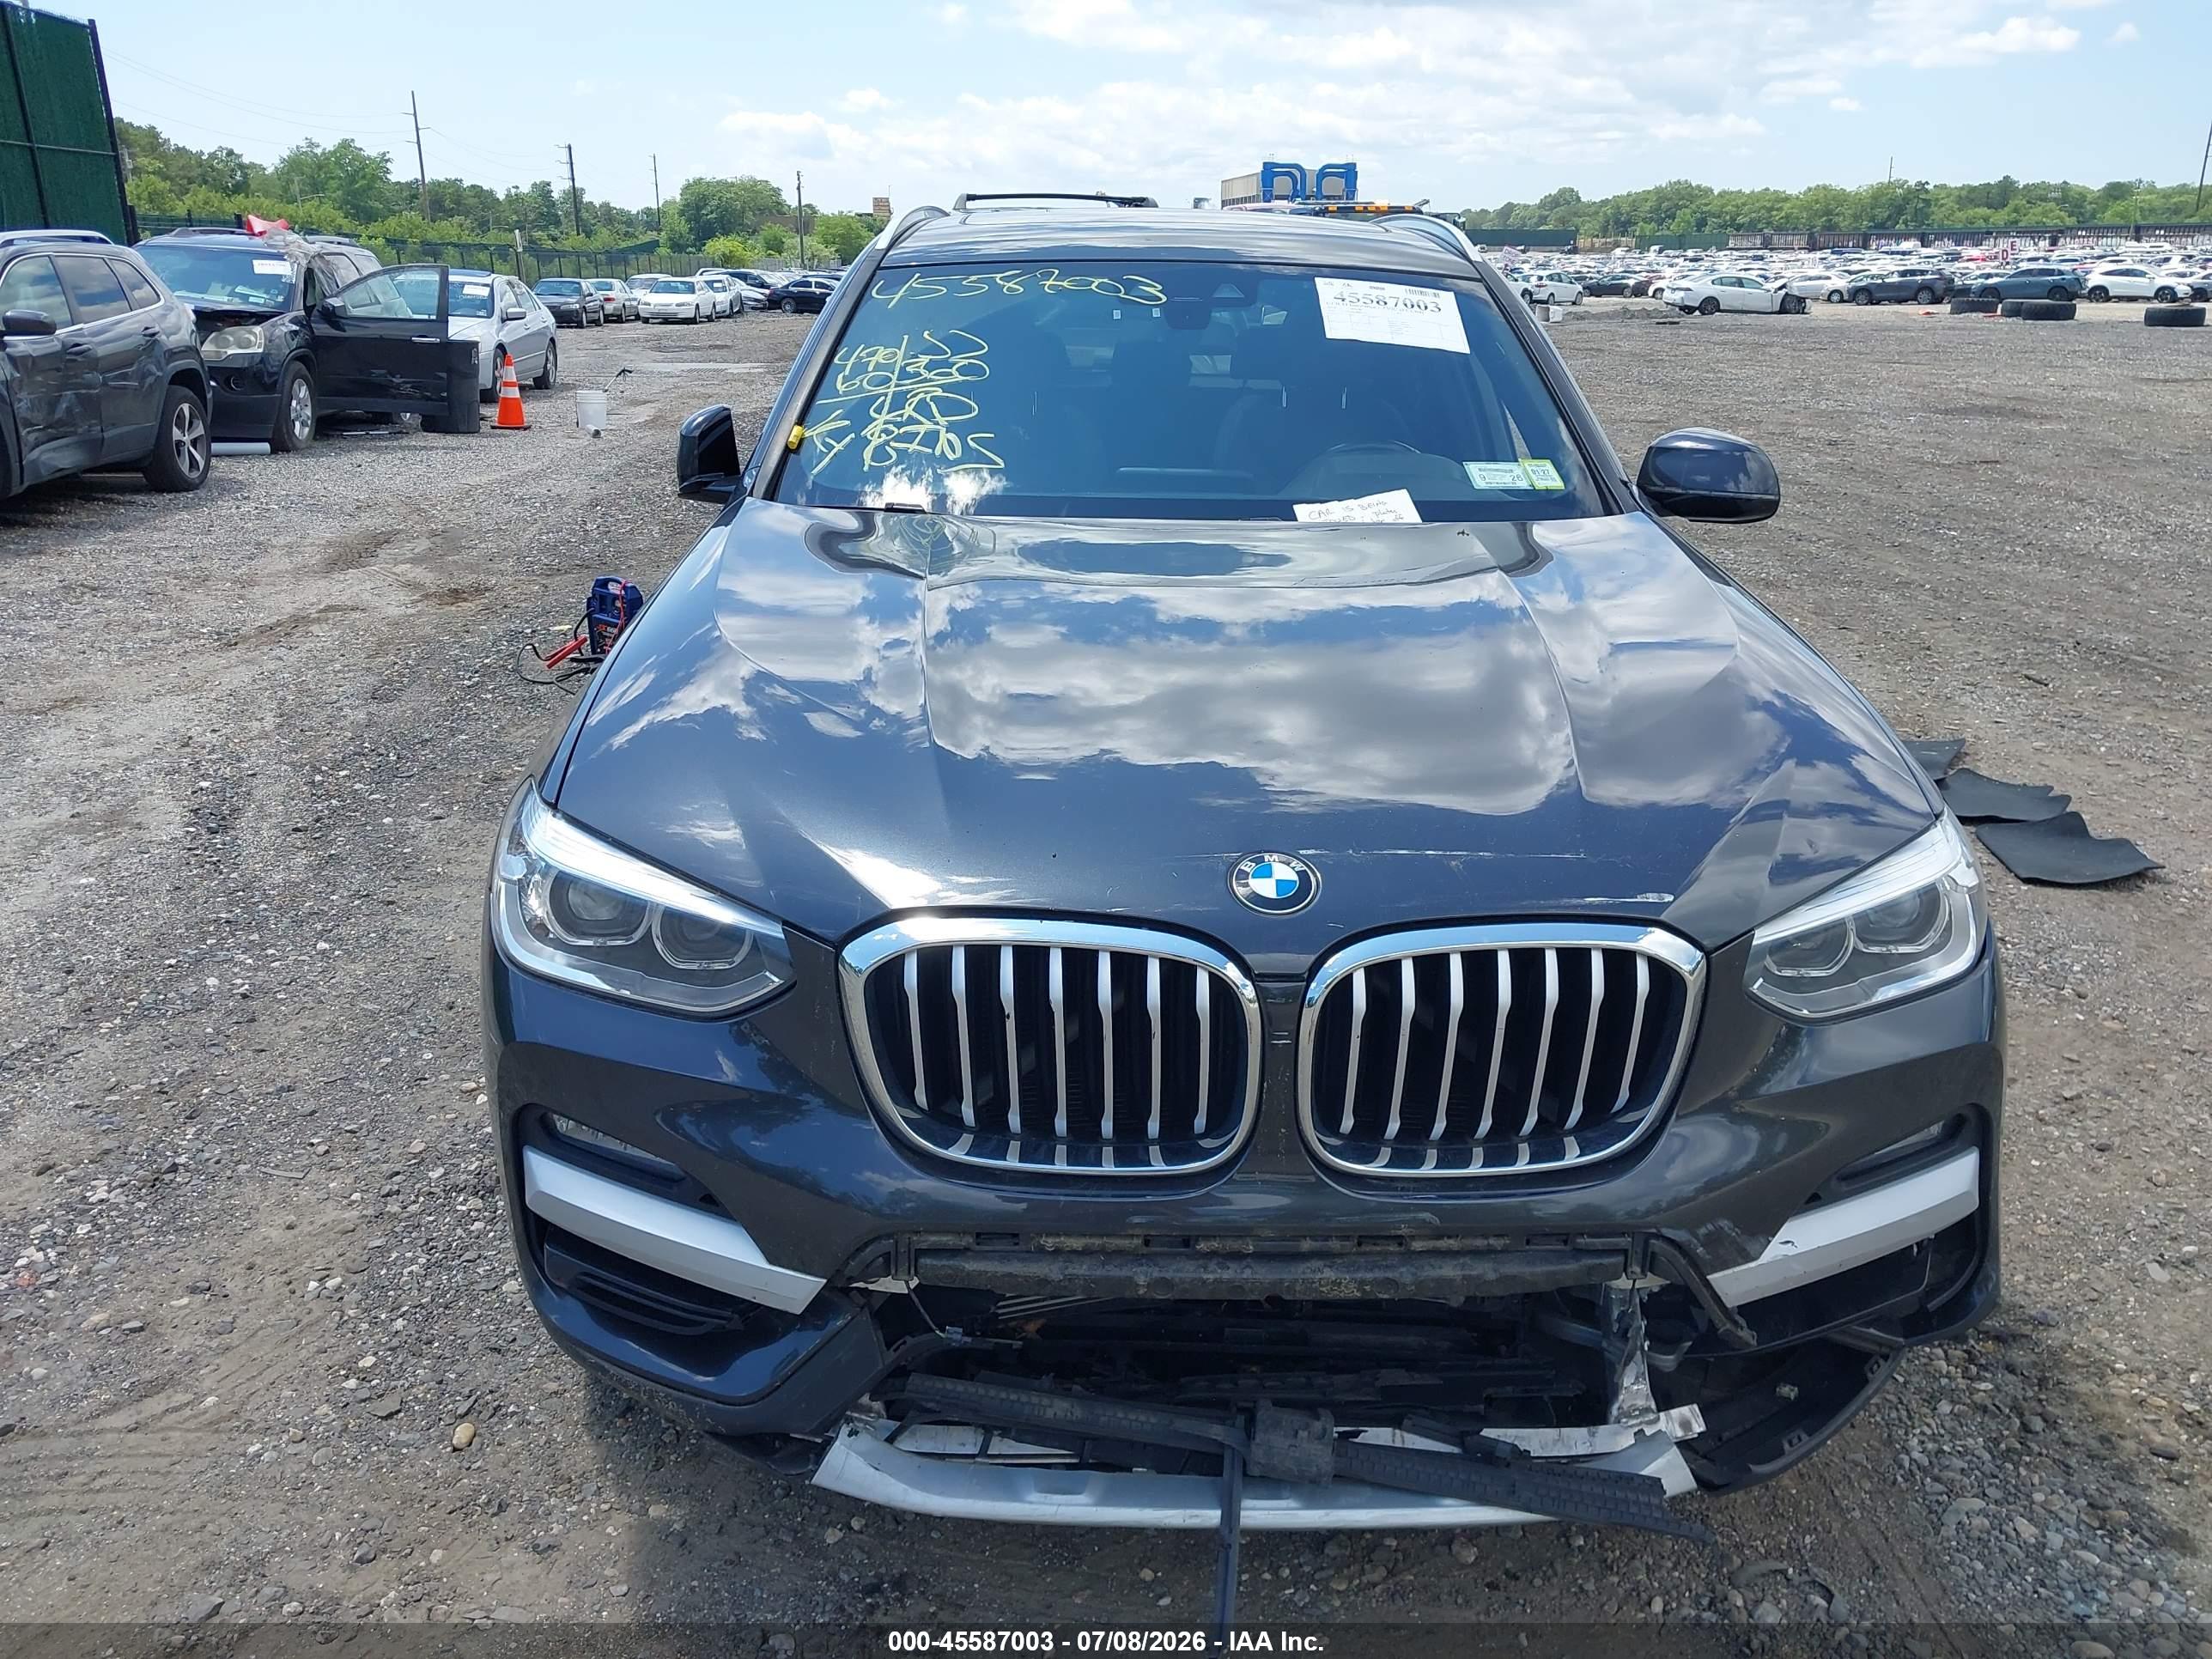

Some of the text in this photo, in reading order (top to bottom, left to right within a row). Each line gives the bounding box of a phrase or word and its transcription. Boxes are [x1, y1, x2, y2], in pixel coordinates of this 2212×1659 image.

[872, 269, 1168, 310] 45587003
[1333, 290, 1443, 313] 45587003
[1240, 854, 1306, 873] BMW
